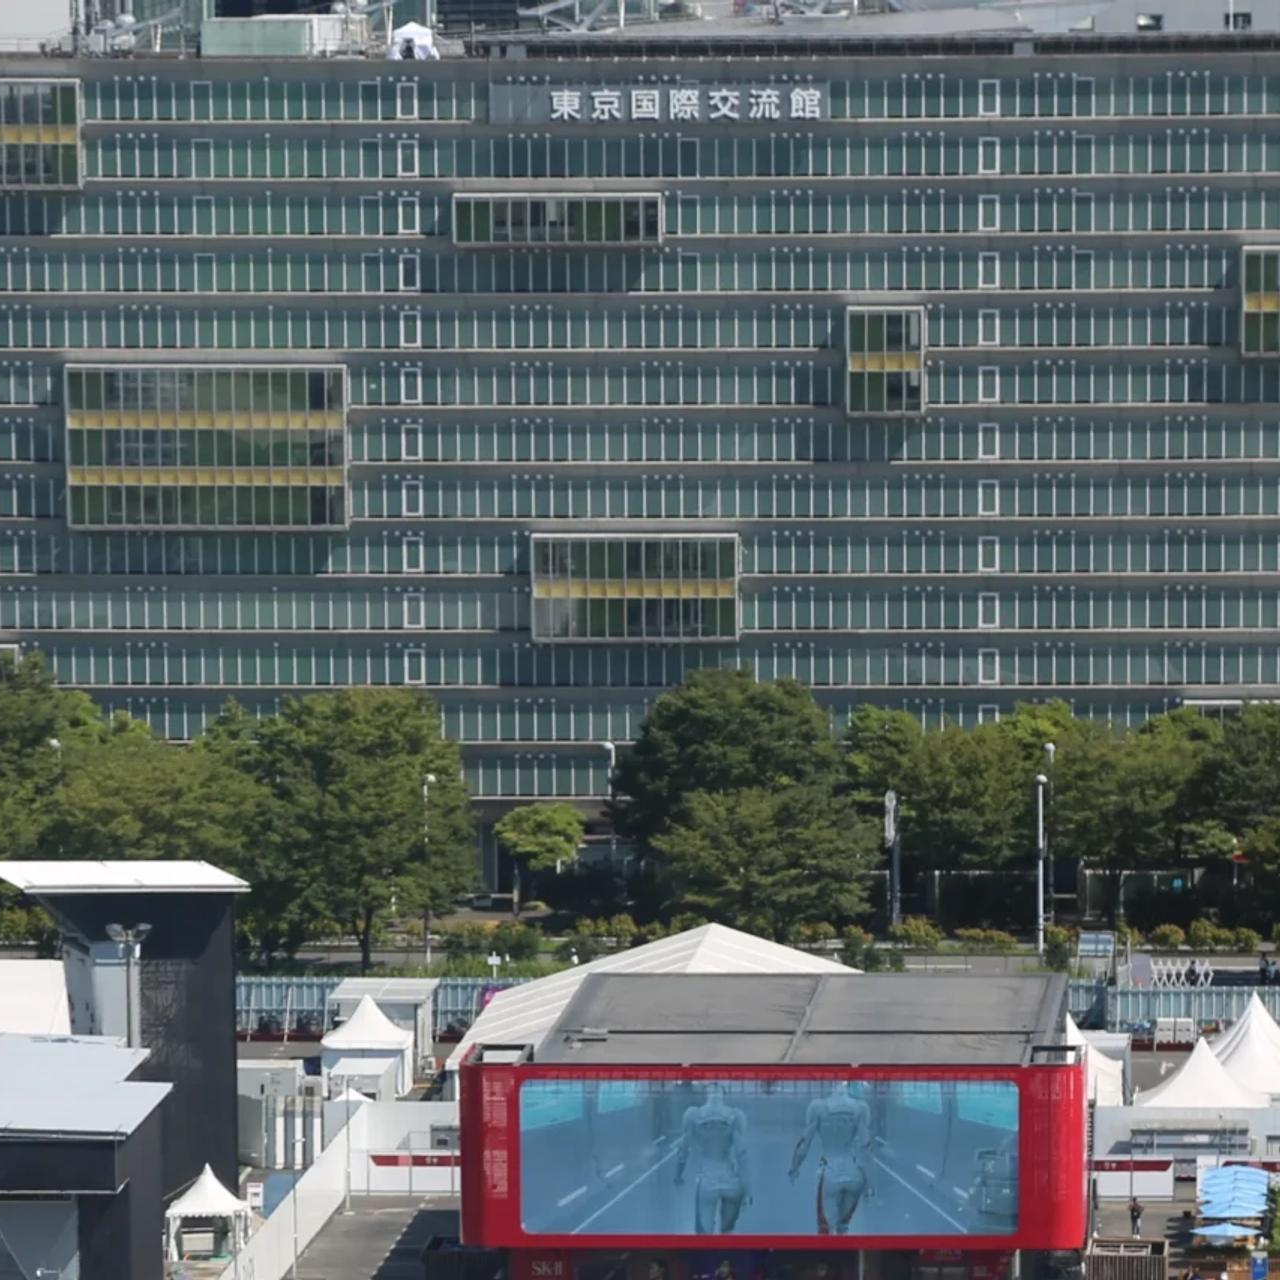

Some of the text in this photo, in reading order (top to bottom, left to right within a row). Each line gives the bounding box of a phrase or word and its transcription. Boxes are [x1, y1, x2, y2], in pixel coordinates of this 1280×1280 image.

[550, 88, 822, 120] 東京国際交流館
